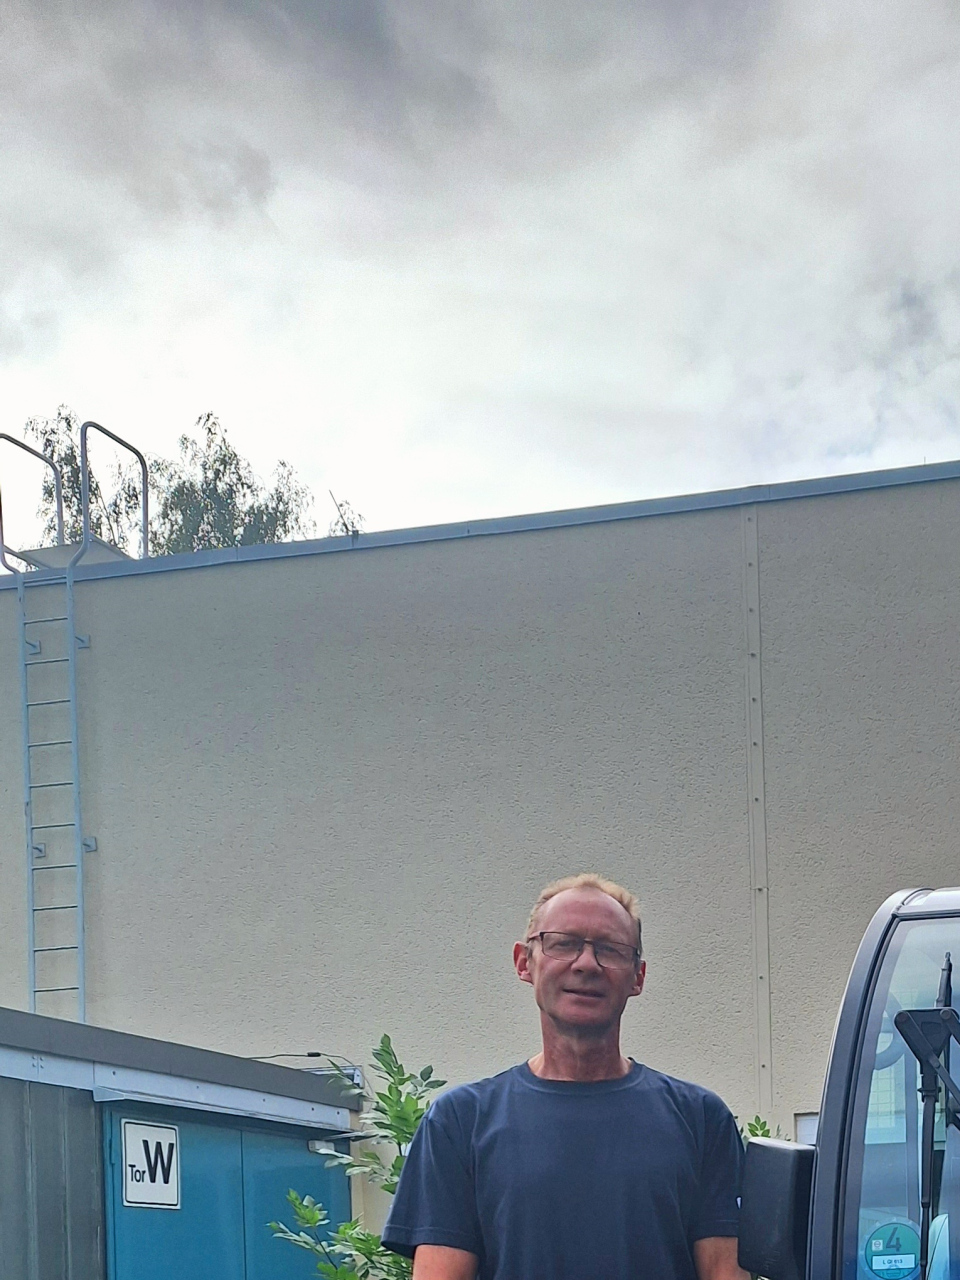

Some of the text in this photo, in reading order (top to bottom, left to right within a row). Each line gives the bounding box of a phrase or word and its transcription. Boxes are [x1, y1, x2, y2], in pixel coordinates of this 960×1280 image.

[128, 1139, 174, 1184] Tor W
[886, 1227, 902, 1252] 4
